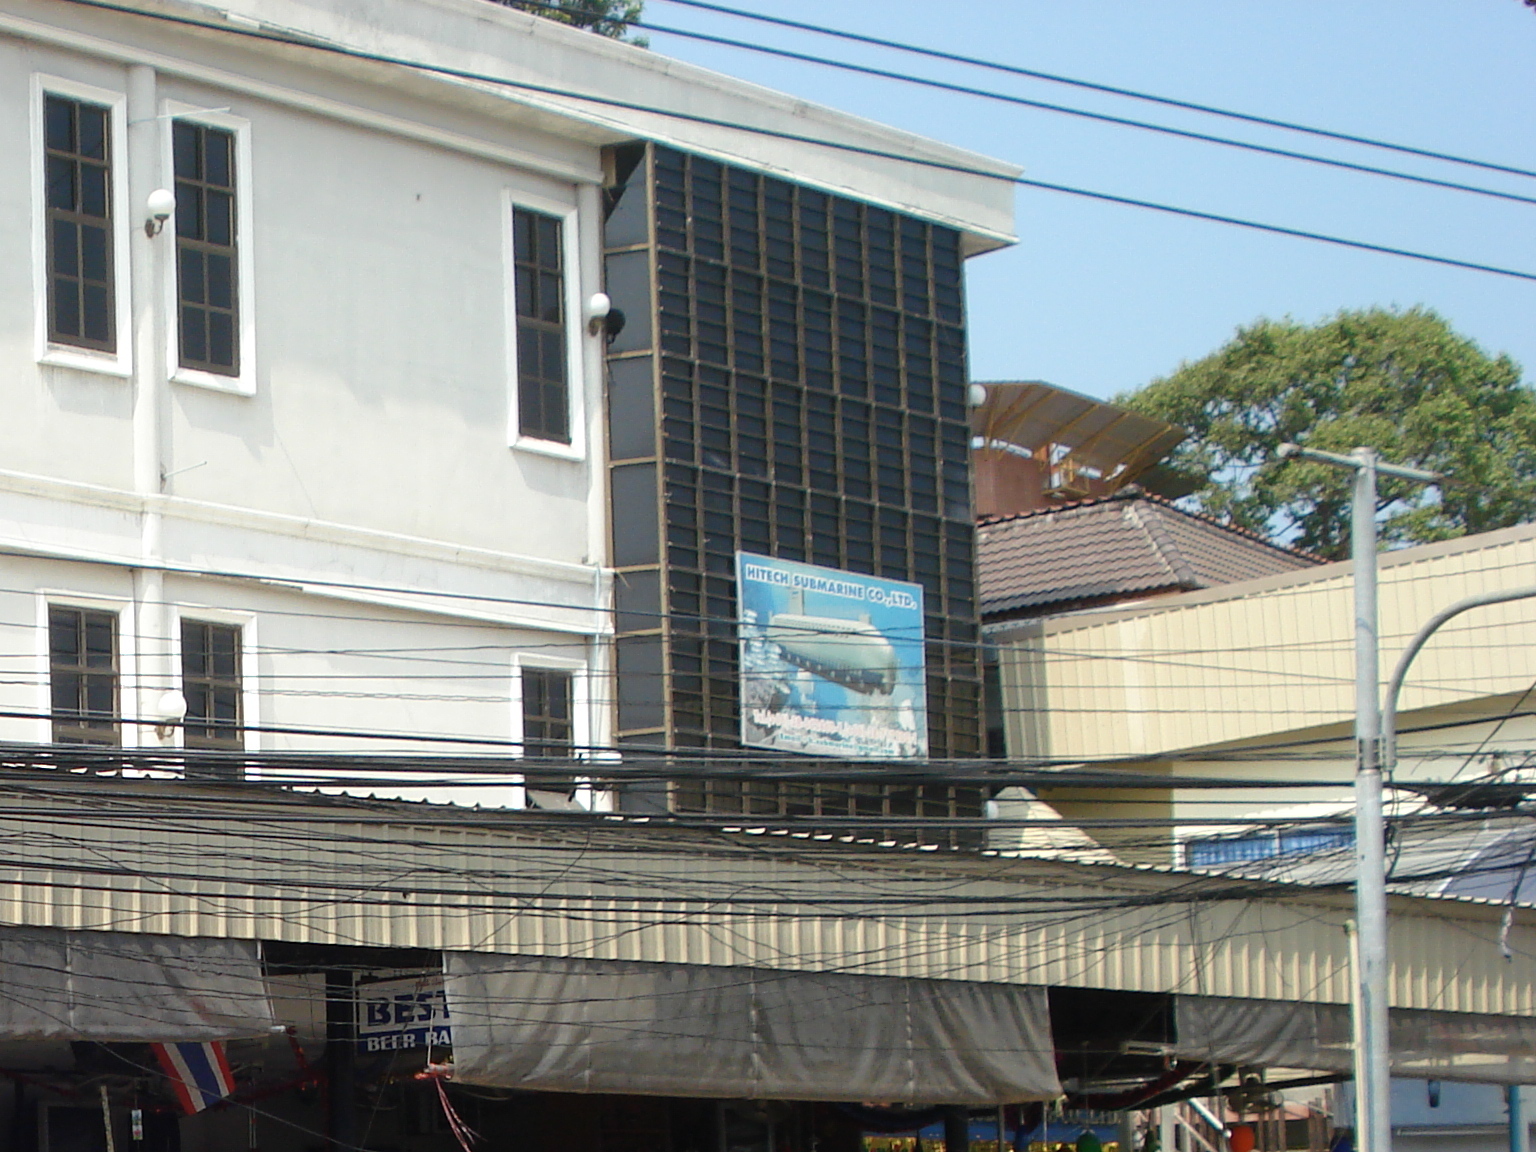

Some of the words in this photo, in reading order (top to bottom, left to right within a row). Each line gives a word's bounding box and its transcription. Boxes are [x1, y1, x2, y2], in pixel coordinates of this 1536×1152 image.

[747, 566, 788, 585] HITECH
[793, 574, 863, 599] SUBMARINE
[367, 1033, 416, 1052] BEER
[425, 1030, 451, 1047] BA
